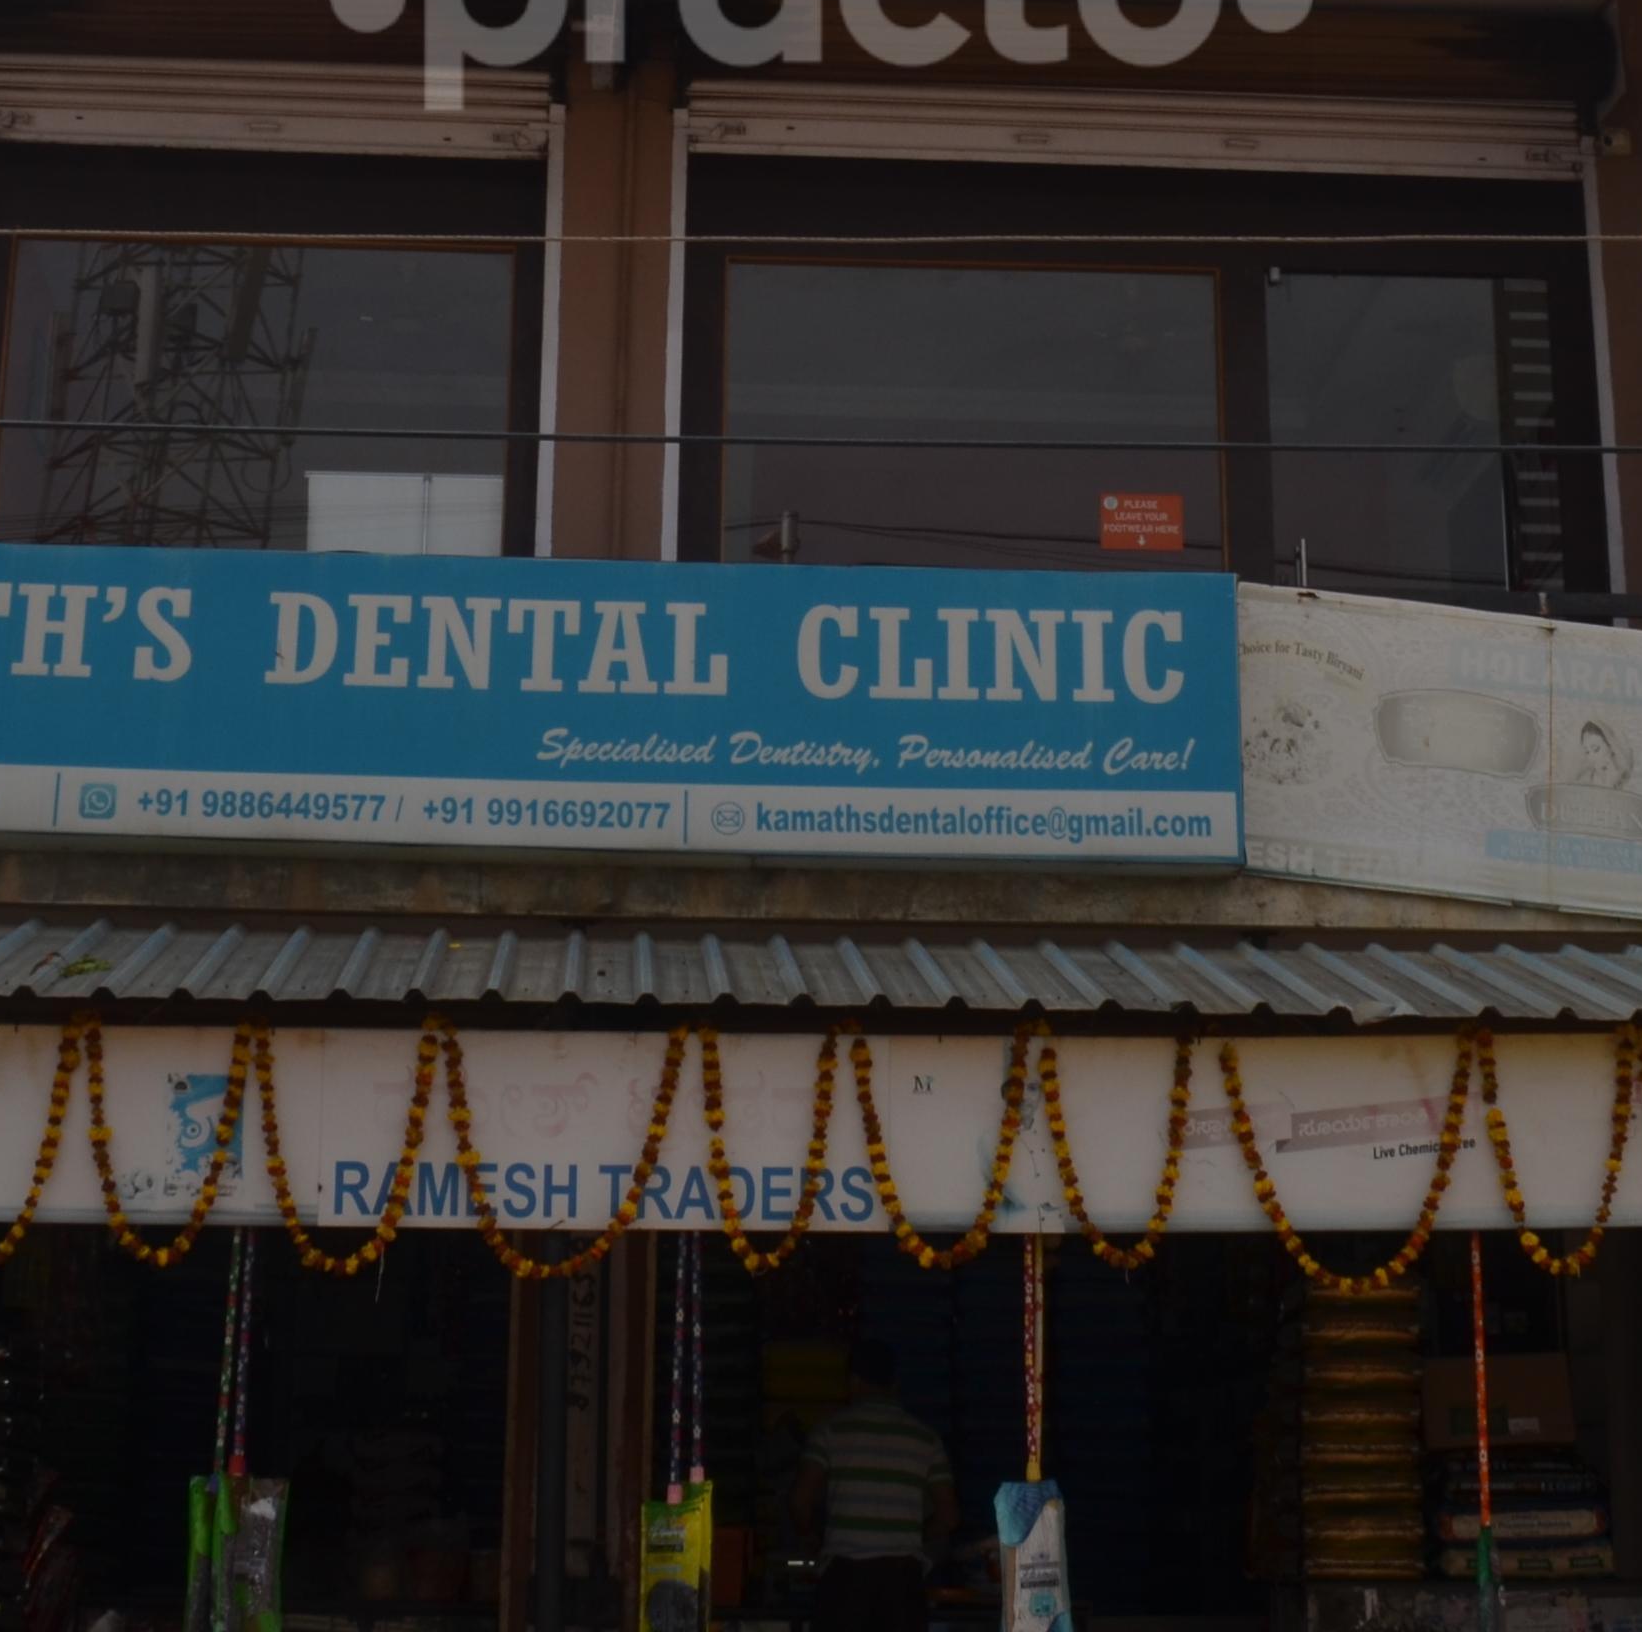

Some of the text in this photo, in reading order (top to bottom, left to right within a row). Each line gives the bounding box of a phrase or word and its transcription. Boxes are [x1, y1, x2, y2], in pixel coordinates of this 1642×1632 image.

[1114, 512, 1168, 521] LEAVE YOUR
[1123, 500, 1158, 510] PLEASE
[1103, 523, 1179, 534] FOOTWEAR HERE
[264, 591, 729, 697] DENTAL
[796, 603, 1185, 705] CLINIC
[1240, 640, 1366, 681] hoice for Tasty Biryani
[537, 727, 715, 765] Specialised
[897, 734, 1092, 772] Personalised
[1103, 736, 1198, 777] Care!
[137, 787, 190, 817] +91
[201, 788, 387, 823] 9886449577
[423, 795, 475, 825] +91
[487, 797, 672, 830] 9916692077
[755, 800, 1213, 846] kamathsdentaloffice@gmail.com
[1372, 1146, 1396, 1161] Live
[1398, 1140, 1451, 1157] Chemic
[332, 1159, 875, 1222] RAMESH TRADERS
